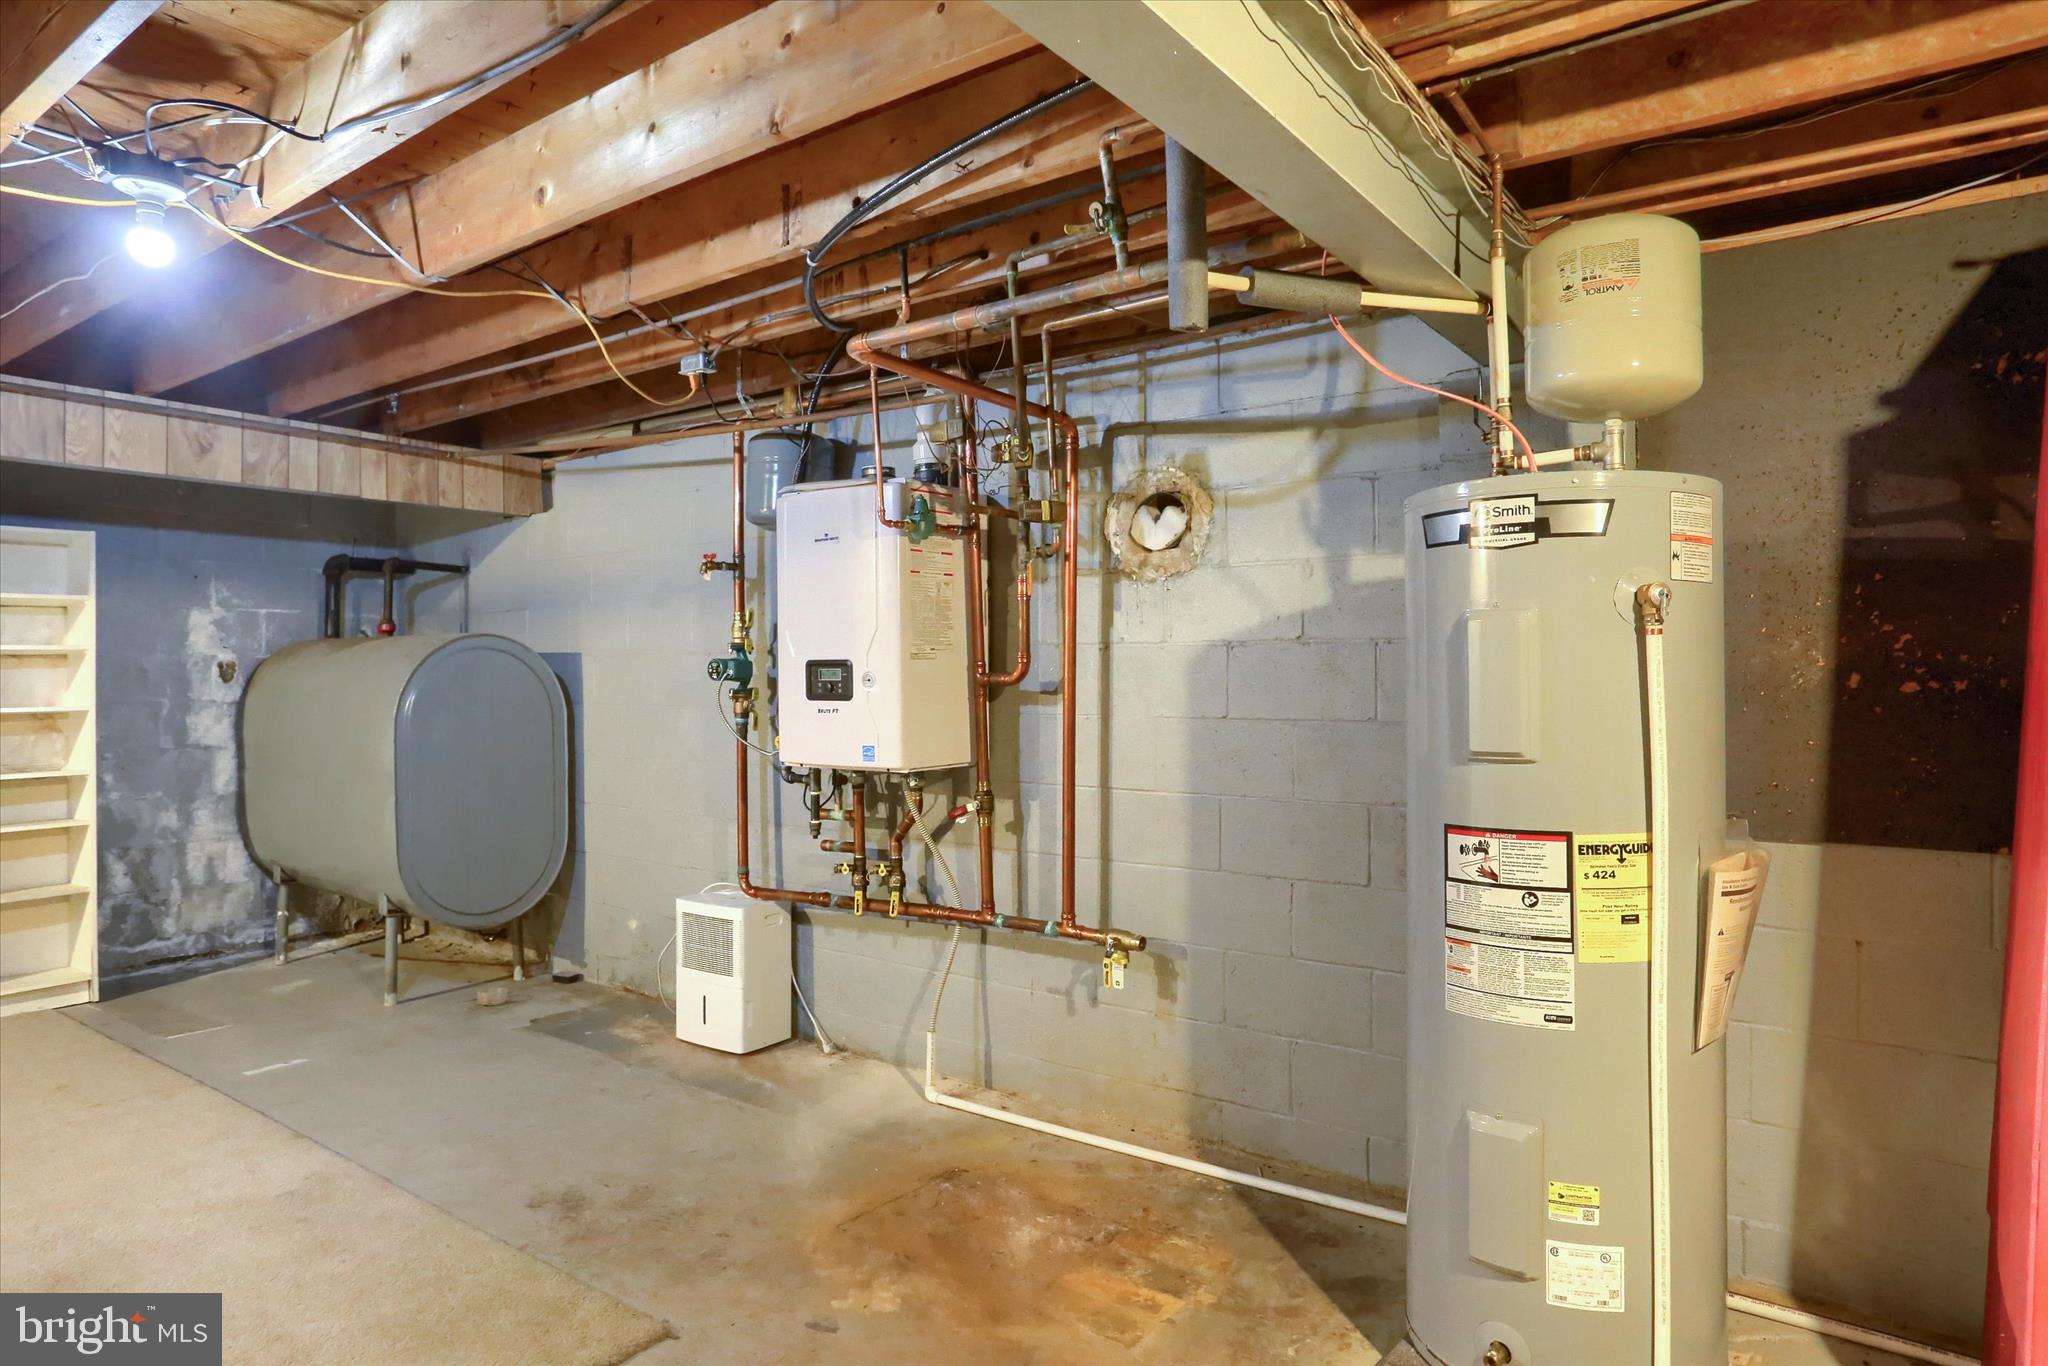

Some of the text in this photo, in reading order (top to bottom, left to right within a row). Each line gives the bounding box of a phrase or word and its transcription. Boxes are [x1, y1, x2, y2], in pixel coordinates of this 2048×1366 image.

[1584, 283, 1624, 296] AMTROL
[1492, 504, 1531, 518] Smith
[1592, 870, 1616, 880] 424
